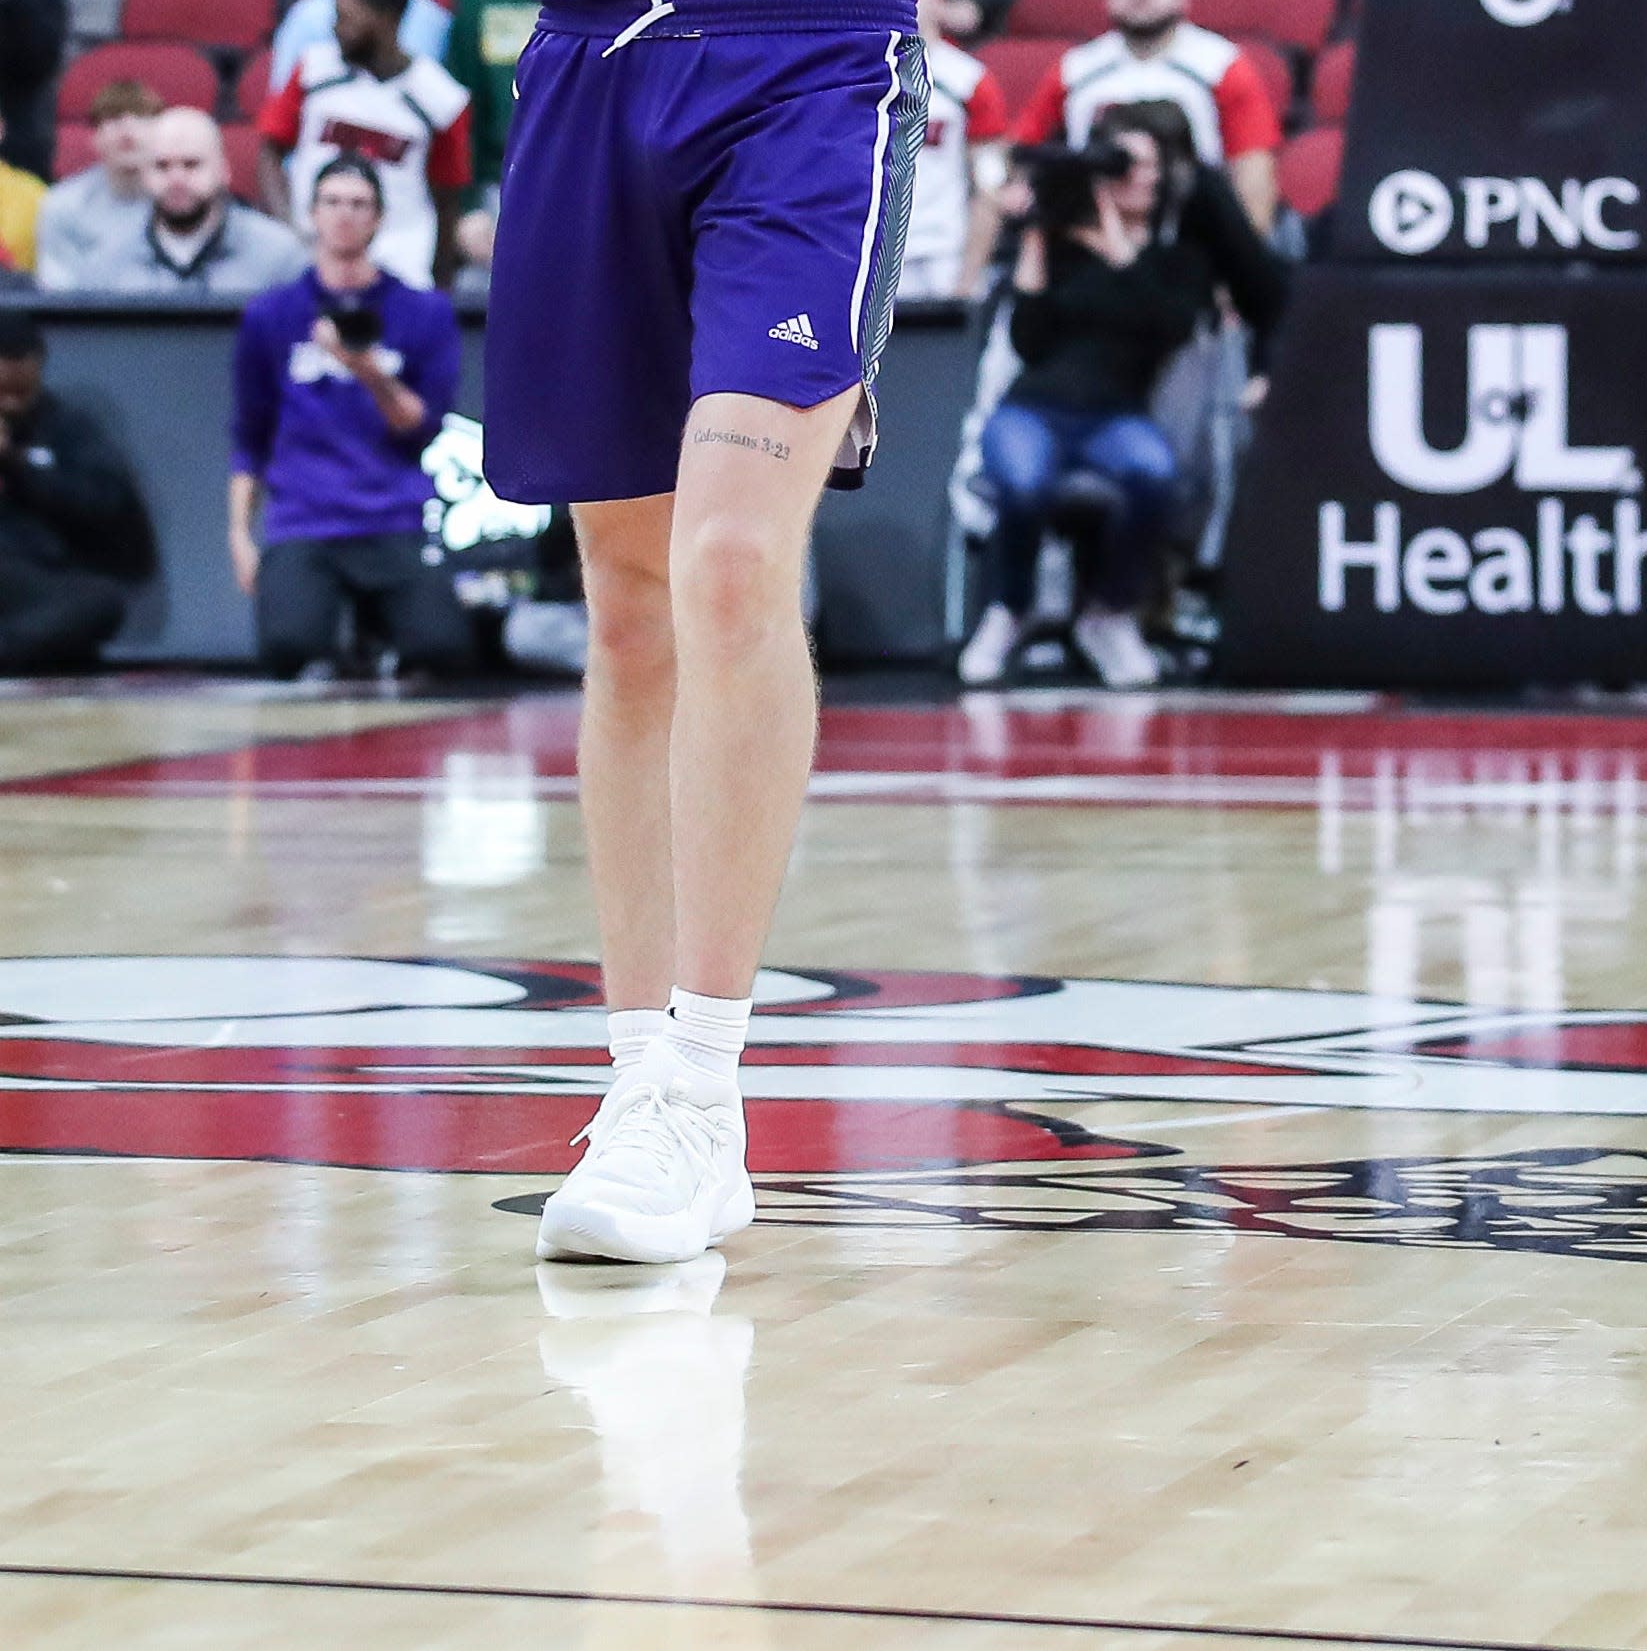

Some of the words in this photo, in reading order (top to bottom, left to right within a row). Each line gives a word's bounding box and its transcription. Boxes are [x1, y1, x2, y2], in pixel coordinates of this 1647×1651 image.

[1460, 175, 1641, 251] PNC
[768, 326, 820, 351] adidas
[693, 427, 758, 449] Colossians
[762, 436, 791, 462] 3:23
